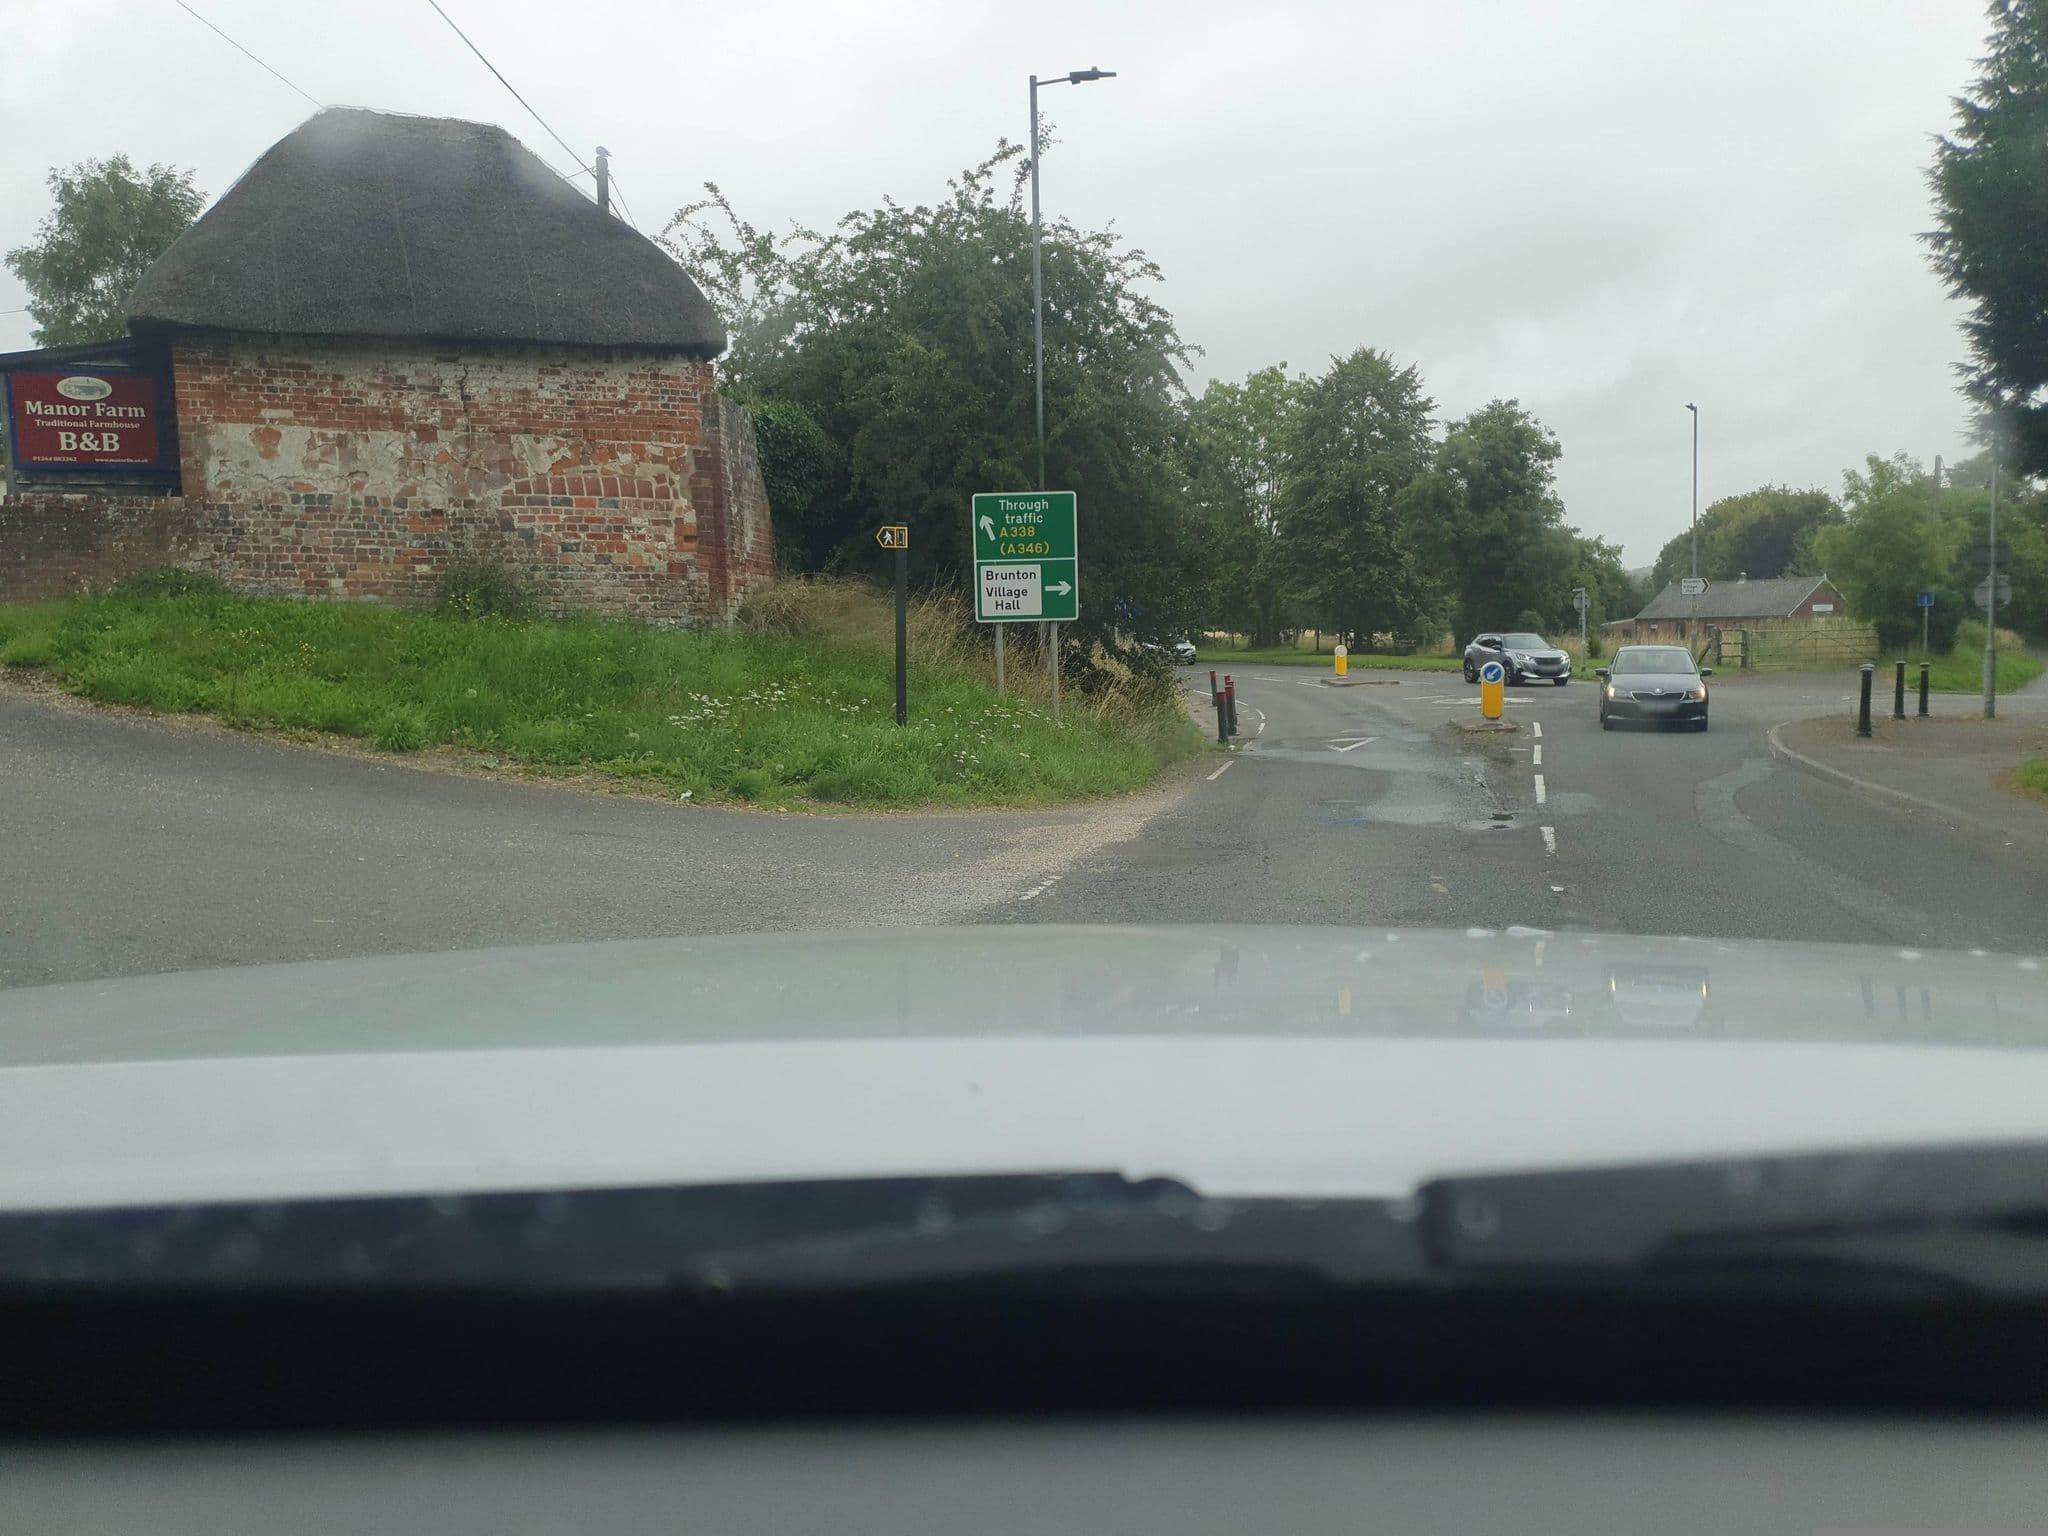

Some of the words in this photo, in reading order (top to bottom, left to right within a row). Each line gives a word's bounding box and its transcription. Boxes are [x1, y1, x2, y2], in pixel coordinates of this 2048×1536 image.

[24, 400, 91, 416] Manor
[95, 402, 146, 418] Farm
[35, 419, 87, 428] Traditional
[89, 420, 140, 429] Farmhouse
[58, 431, 120, 452] B&B
[999, 499, 1049, 511] Through
[1005, 513, 1043, 524] traffic
[1000, 527, 1035, 538] A338
[1000, 541, 1050, 555] (A346)
[986, 570, 1037, 581] Brunton
[986, 587, 1028, 598] Village
[995, 600, 1020, 610] Hall
